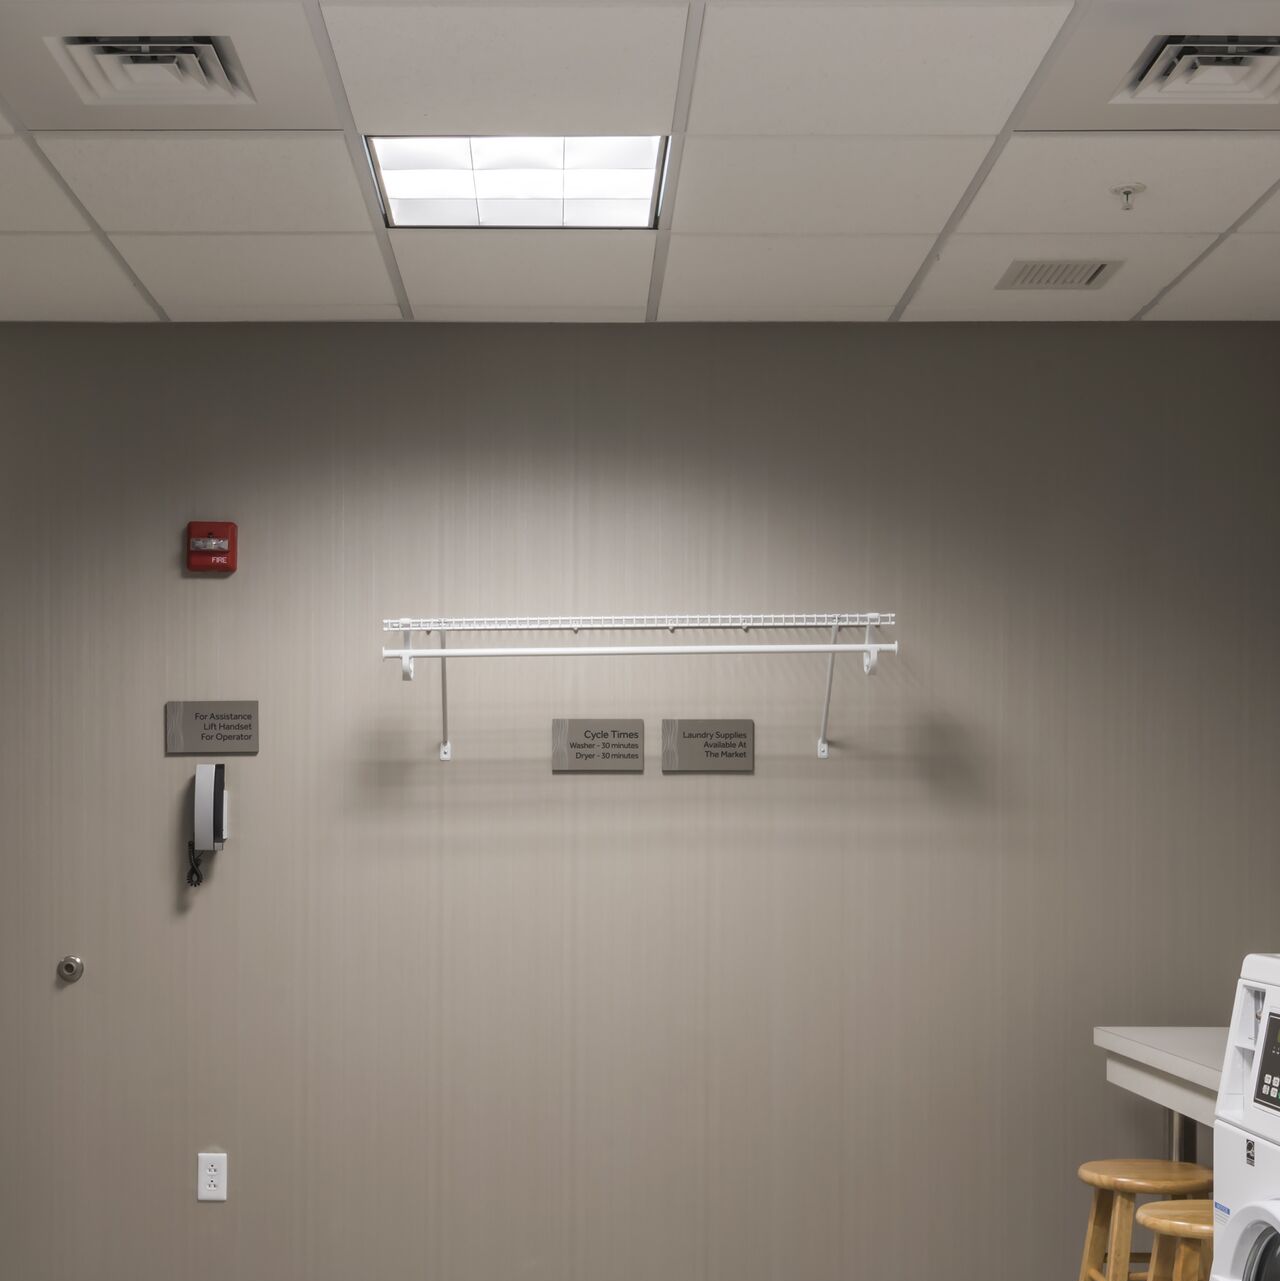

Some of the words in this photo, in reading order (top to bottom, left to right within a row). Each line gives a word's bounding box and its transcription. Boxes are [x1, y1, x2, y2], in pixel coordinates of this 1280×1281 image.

[210, 712, 252, 720] Assistance
[216, 733, 252, 742] Operator
[584, 730, 609, 740] Cycle
[611, 730, 639, 739] Times
[715, 731, 747, 740] Supplies
[575, 752, 595, 760] Dryer
